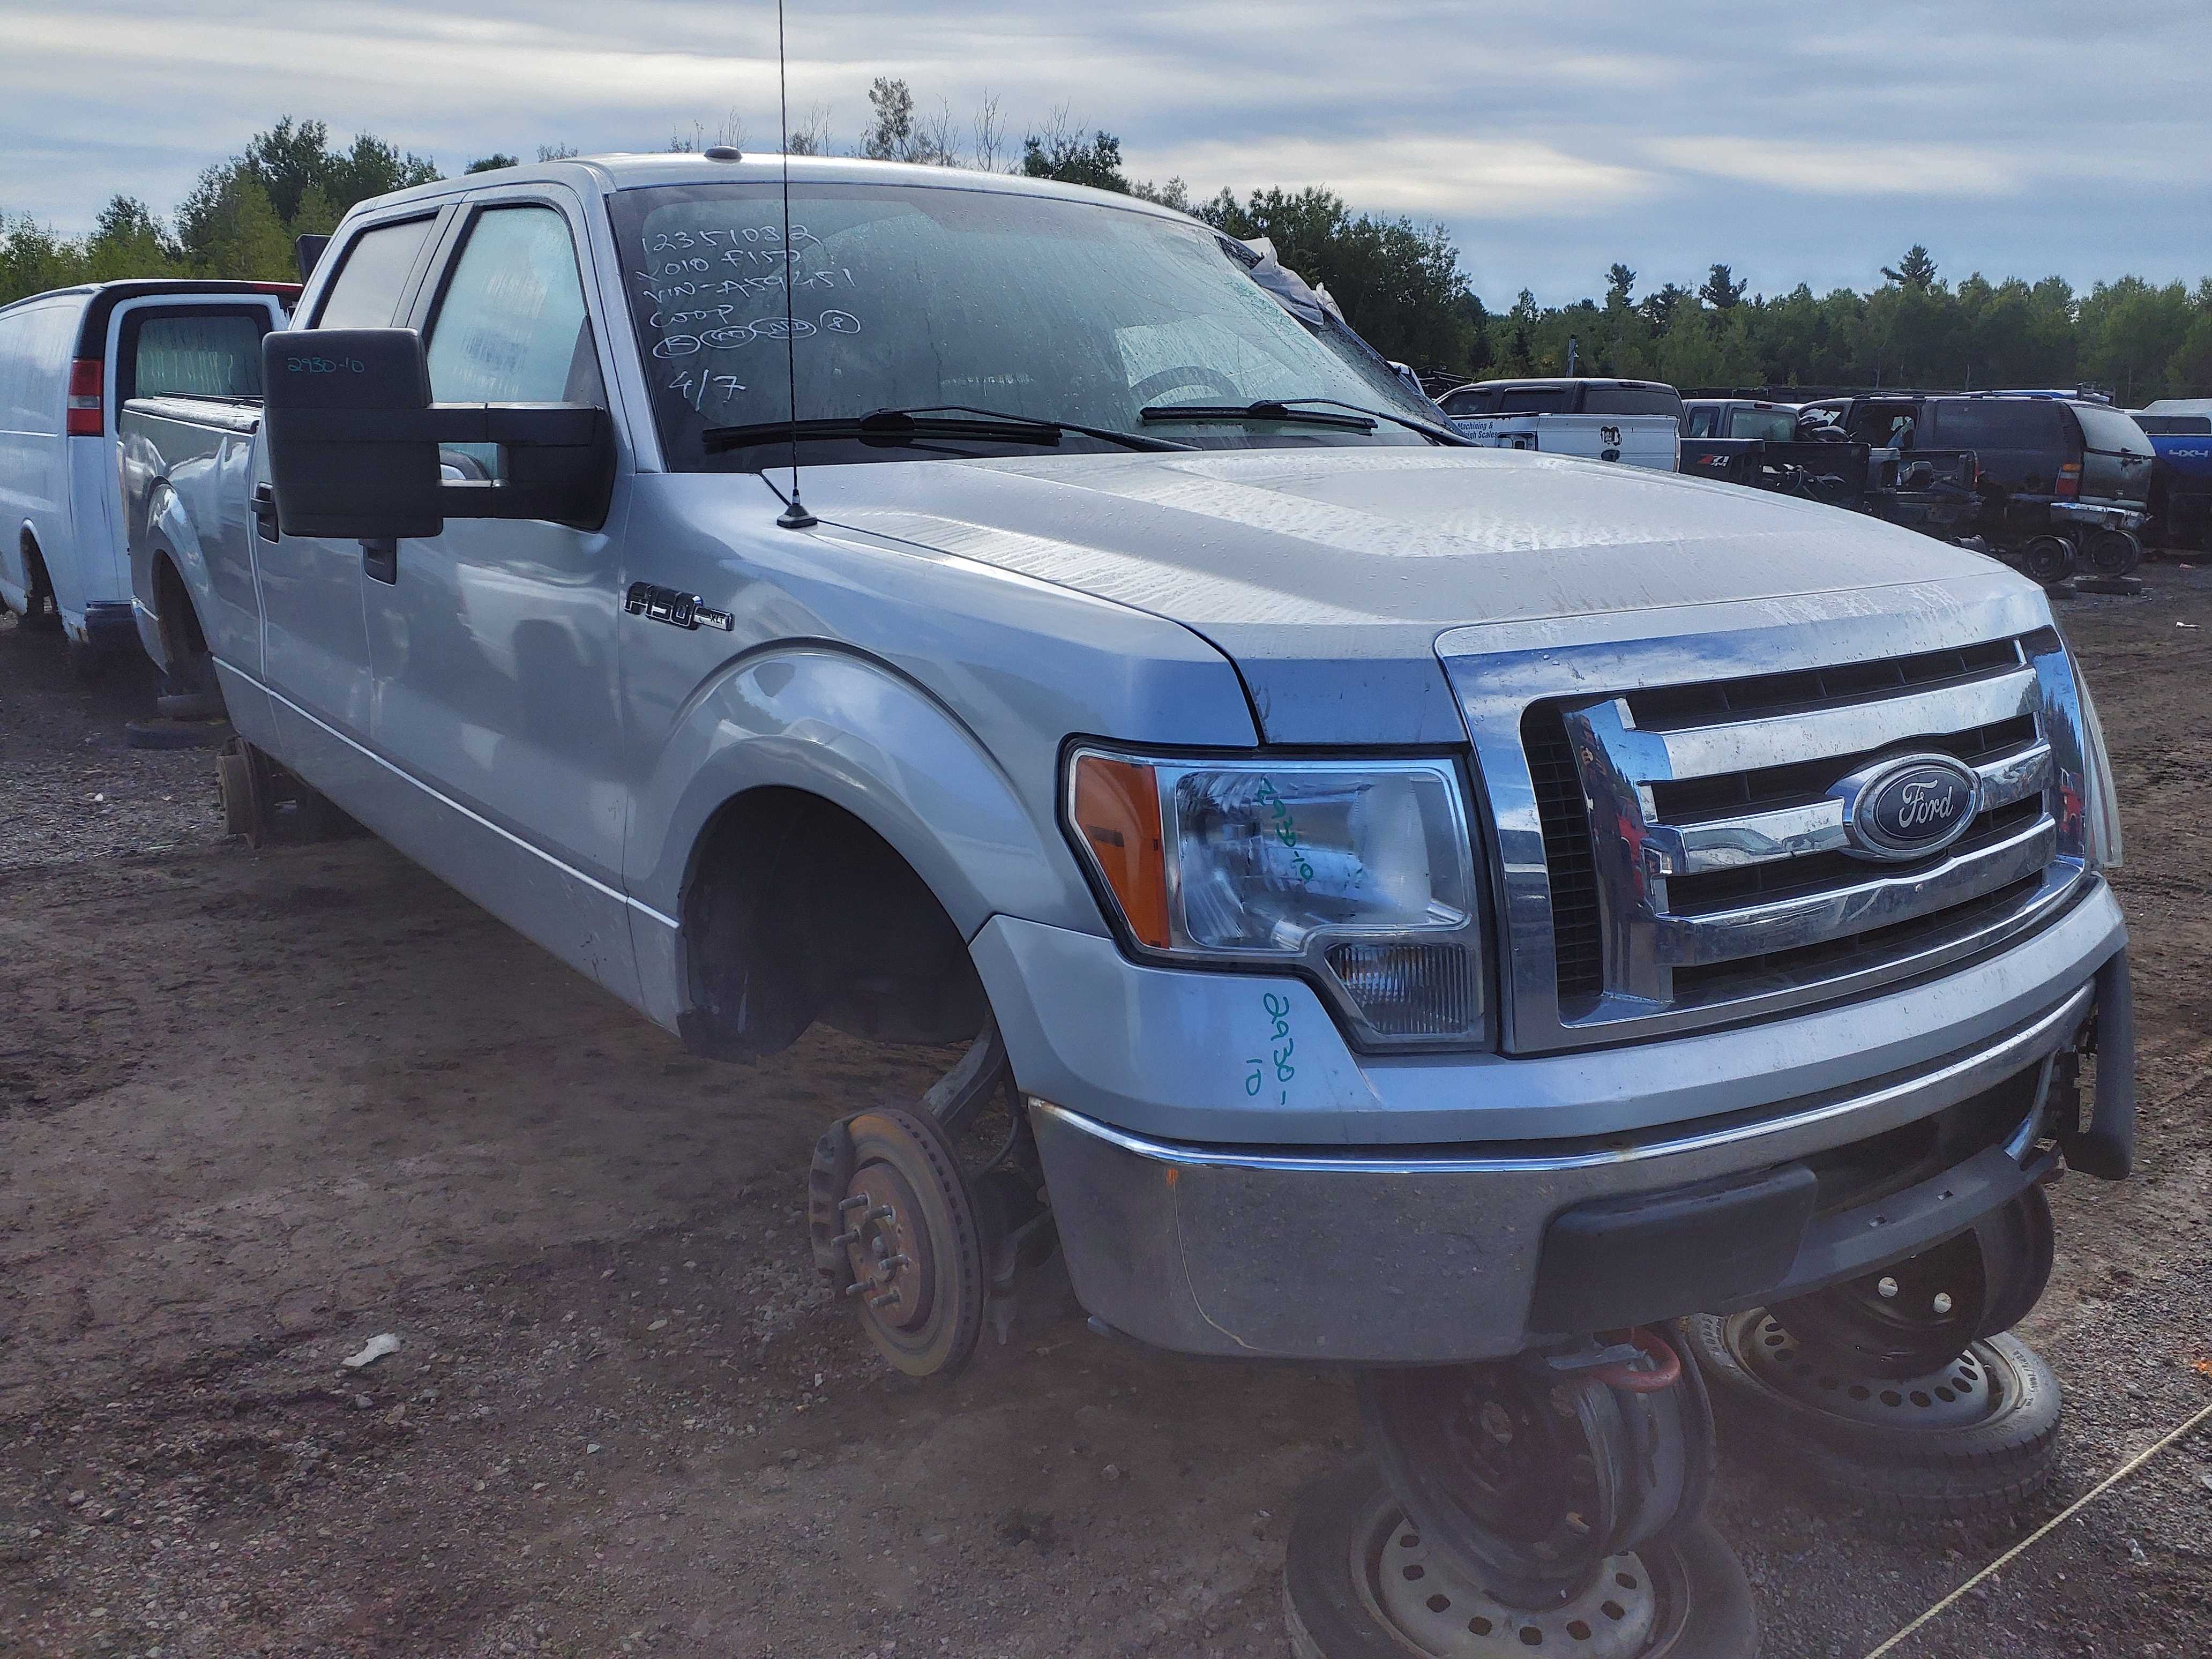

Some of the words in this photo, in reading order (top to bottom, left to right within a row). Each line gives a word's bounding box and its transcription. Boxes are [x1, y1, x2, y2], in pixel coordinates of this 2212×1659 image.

[721, 249, 801, 267] F150
[669, 369, 746, 412] 4/7
[1458, 422, 1487, 431] Machining
[1489, 421, 1493, 429] &
[1478, 430, 1498, 438] Scales
[710, 613, 724, 625] XLT
[1899, 779, 1953, 828] Ford
